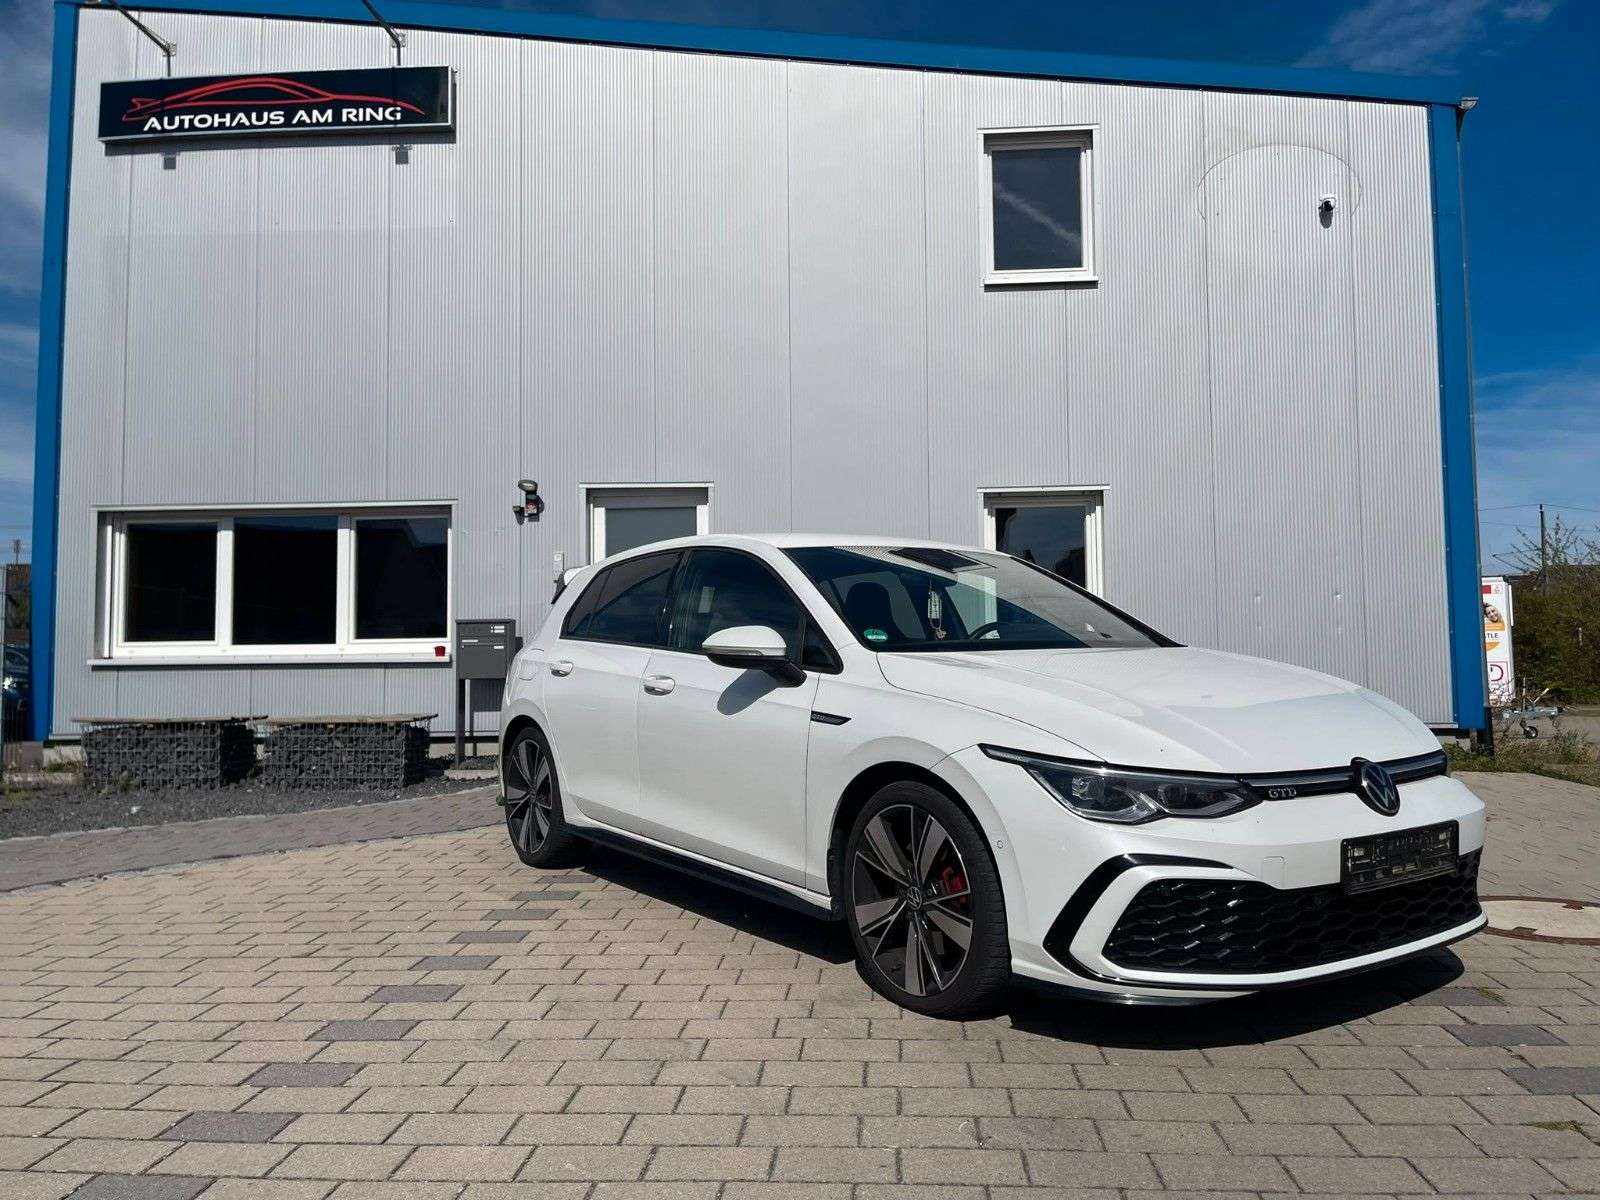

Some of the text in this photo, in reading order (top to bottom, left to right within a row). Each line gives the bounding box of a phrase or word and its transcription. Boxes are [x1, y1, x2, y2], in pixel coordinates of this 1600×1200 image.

[143, 106, 403, 132] AUTOHAUS AM RING
[1268, 787, 1297, 798] GTD
